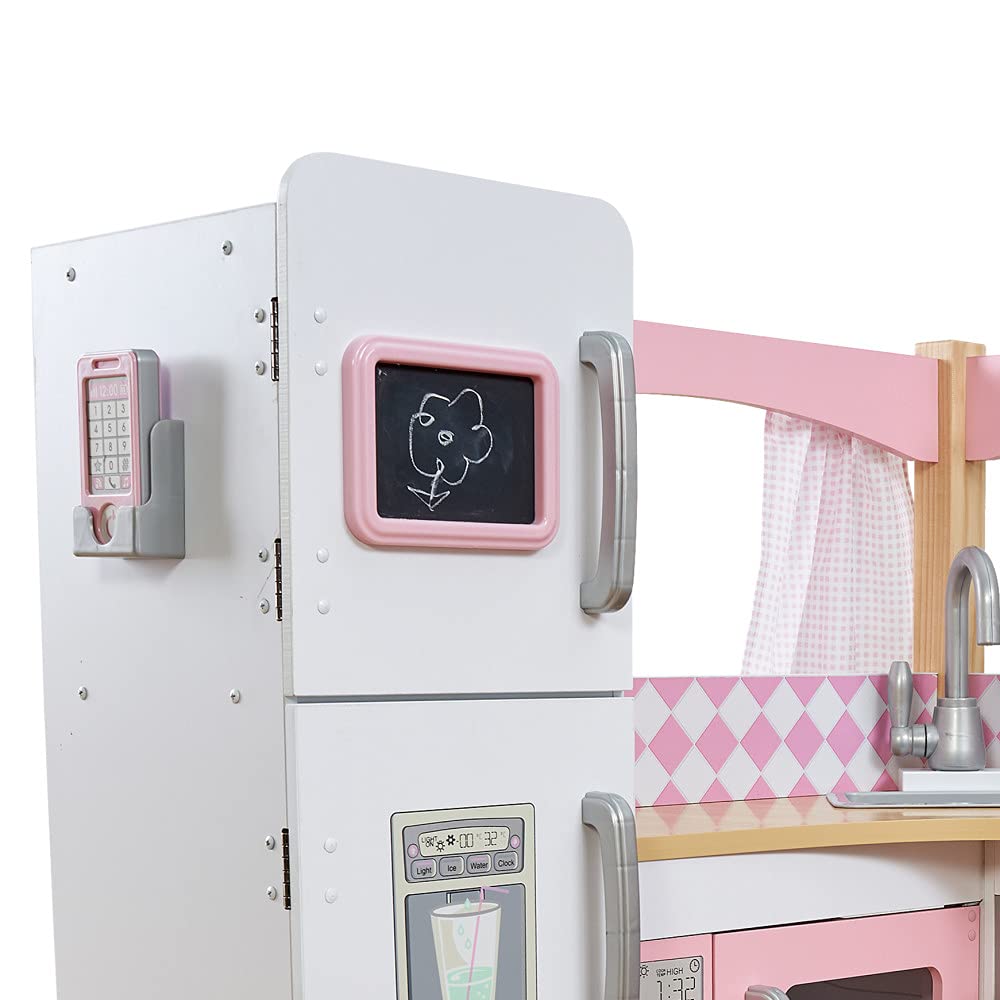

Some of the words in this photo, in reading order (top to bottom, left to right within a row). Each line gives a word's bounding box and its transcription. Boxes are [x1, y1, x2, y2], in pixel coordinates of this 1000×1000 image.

[94, 406, 98, 416] 1
[107, 405, 112, 415] 2
[121, 404, 126, 413] 3
[94, 425, 99, 434] 4
[108, 423, 112, 433] 5
[122, 423, 126, 432] 6
[95, 443, 99, 453] 7
[109, 442, 113, 452] 8
[123, 441, 127, 450] 9
[109, 460, 113, 471] 0
[484, 831, 498, 847] 32
[416, 866, 432, 877] Light
[447, 865, 457, 873] Ice
[470, 862, 489, 871] Water
[497, 860, 515, 868] Clock
[666, 967, 684, 976] HIGH
